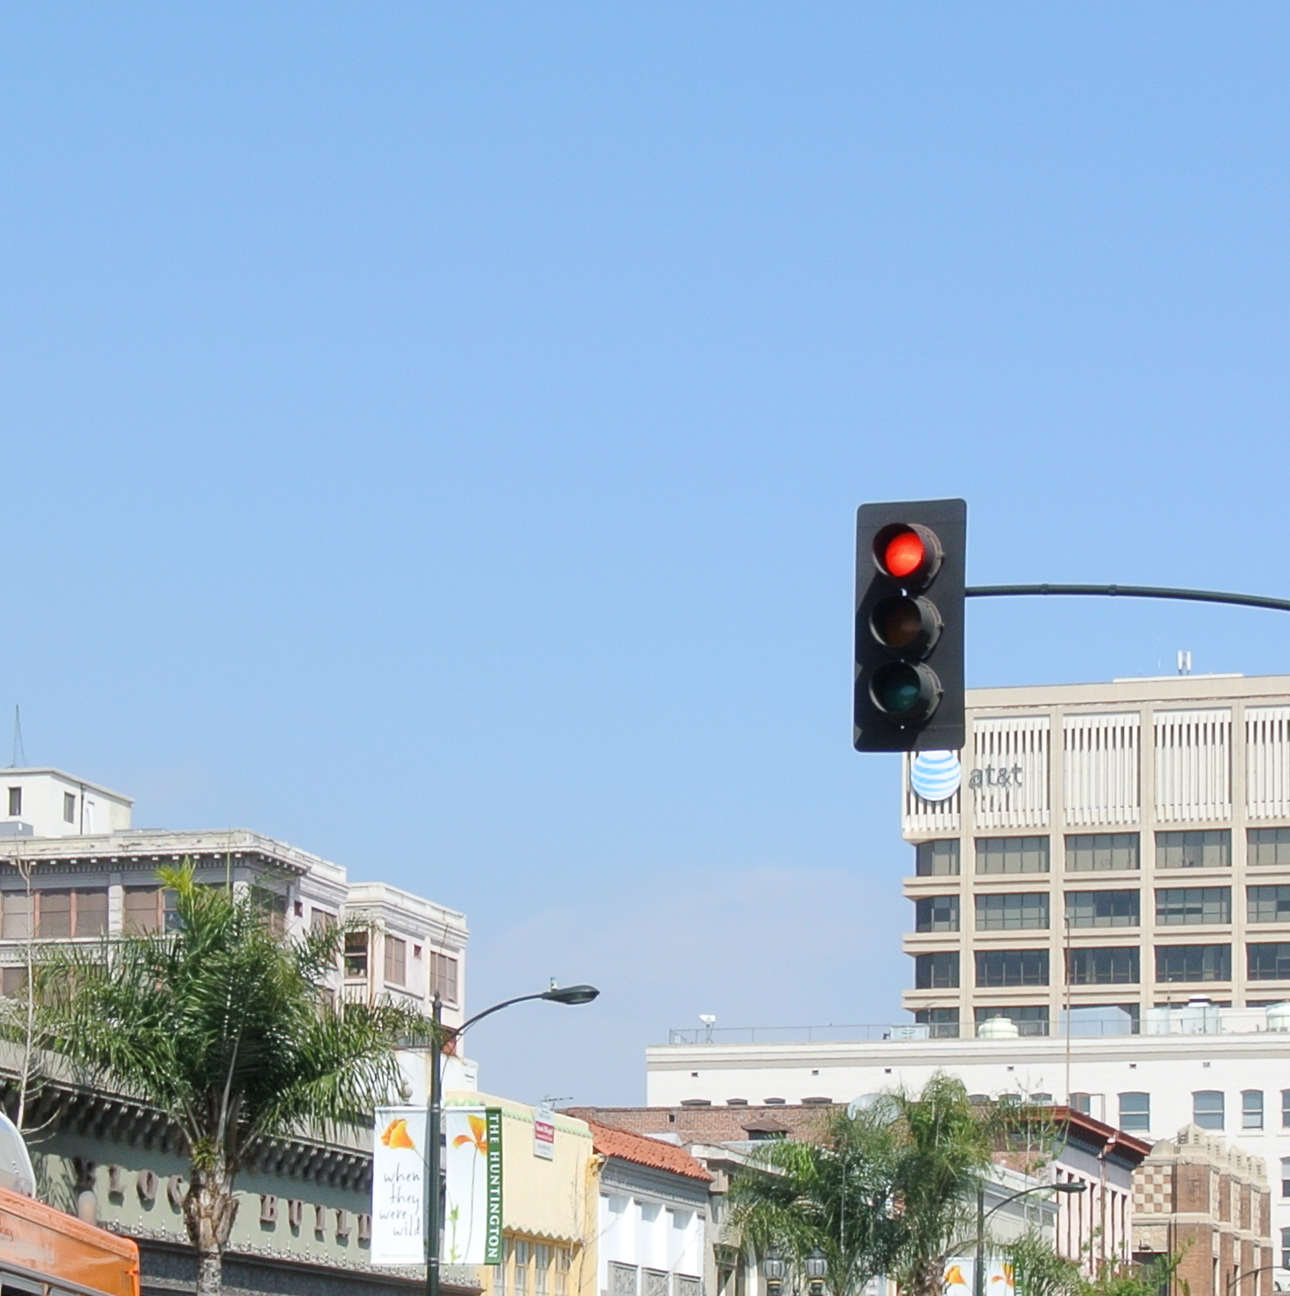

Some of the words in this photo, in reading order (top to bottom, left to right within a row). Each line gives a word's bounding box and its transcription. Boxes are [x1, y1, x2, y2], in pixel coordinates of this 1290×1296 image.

[969, 763, 1022, 788] at&t
[488, 1114, 499, 1143] THE
[383, 1162, 420, 1182] when
[389, 1183, 420, 1215] they
[488, 1152, 500, 1258] HUNTINGTON
[379, 1209, 407, 1221] were
[393, 1215, 422, 1237] wild
